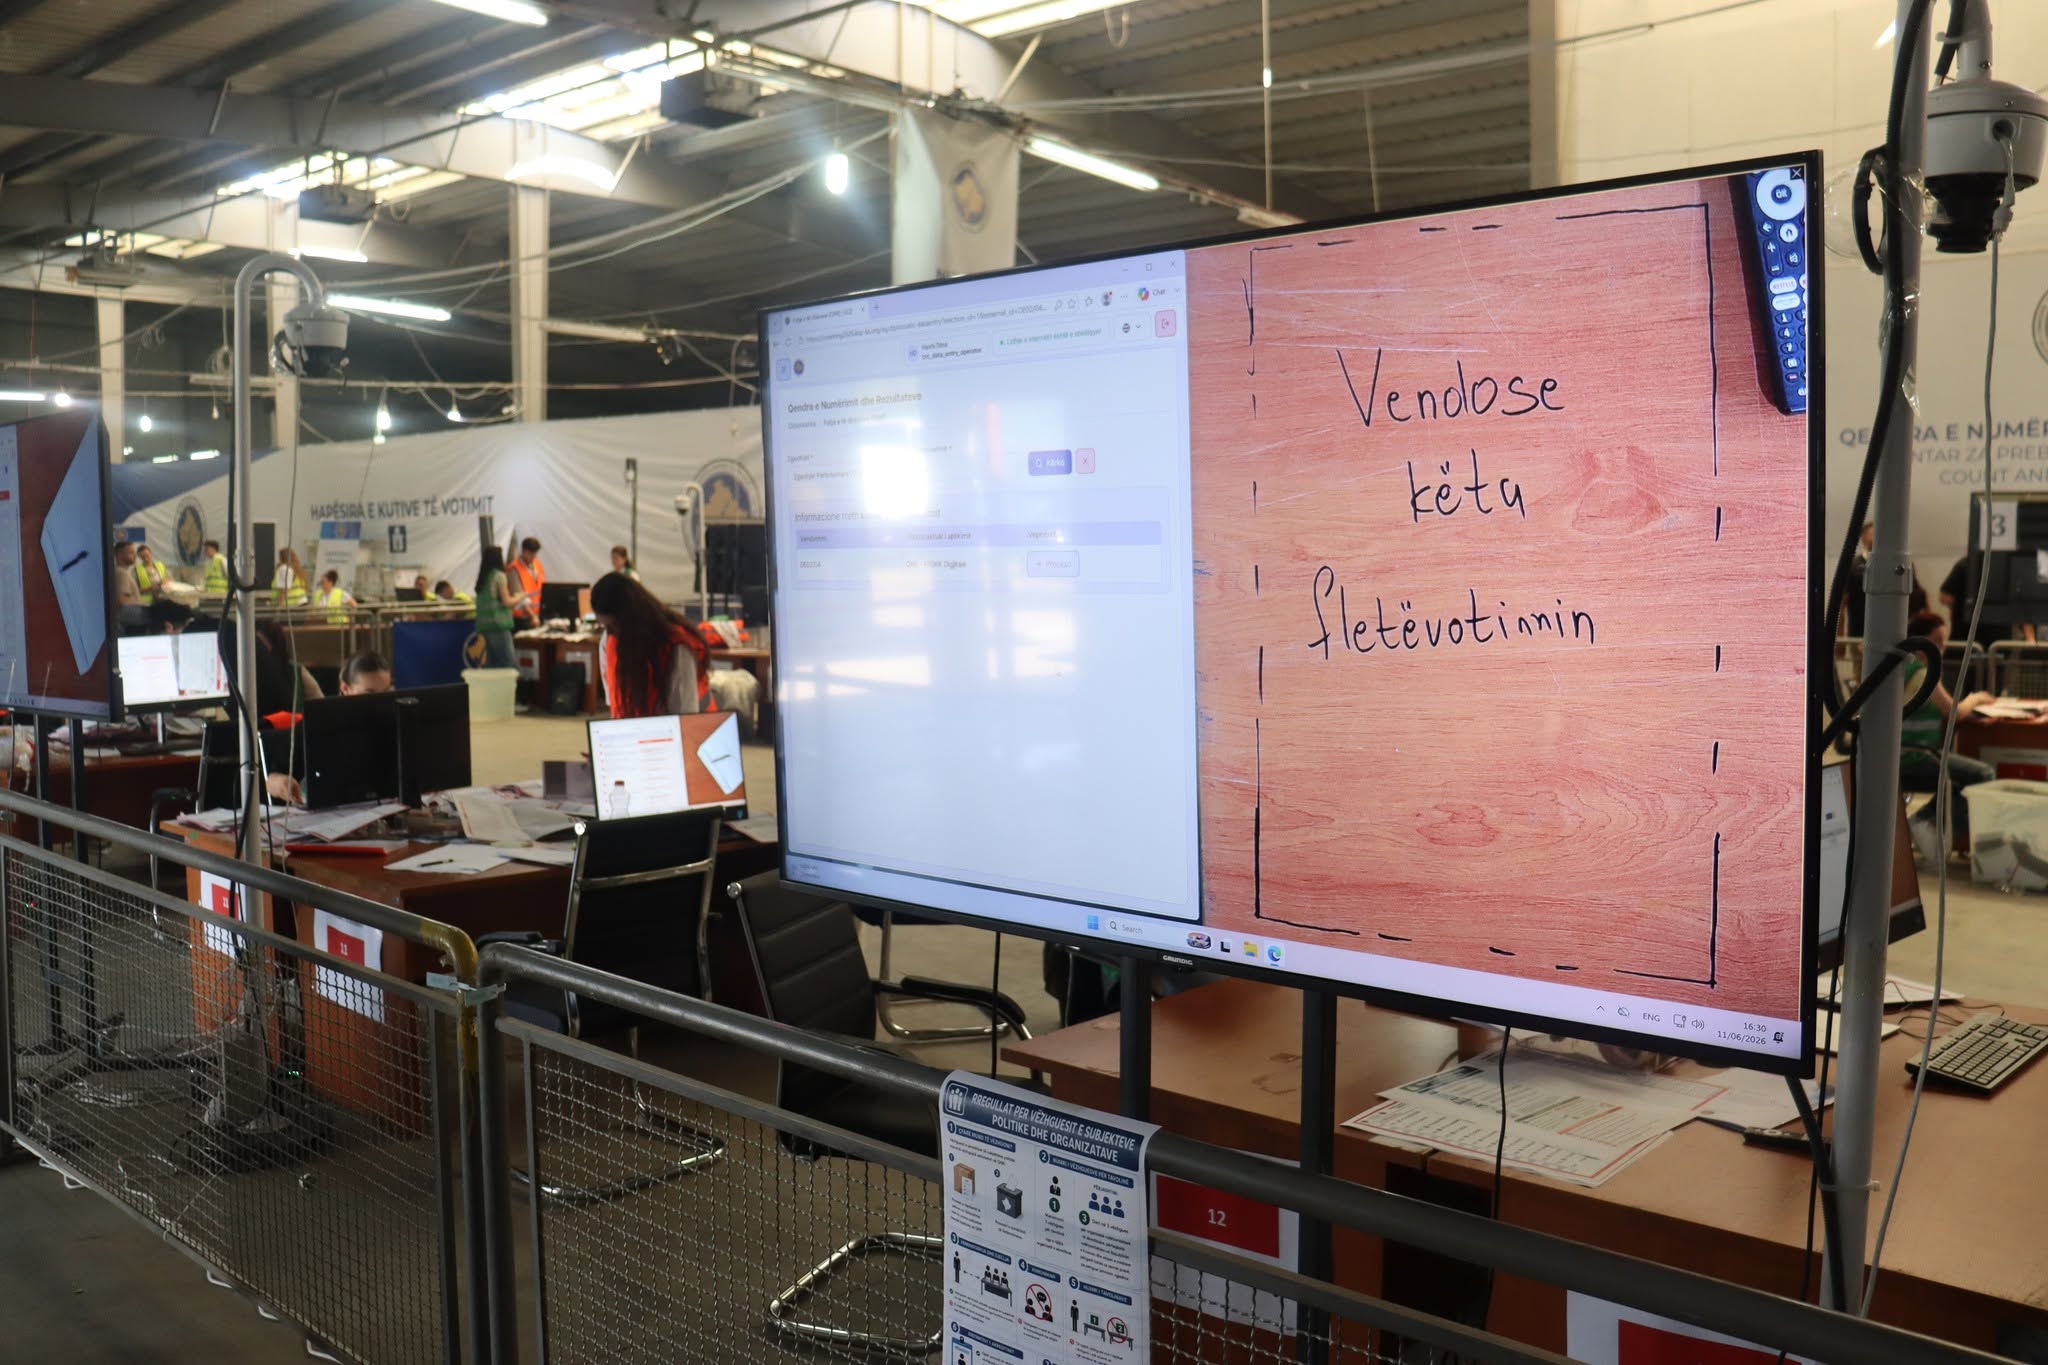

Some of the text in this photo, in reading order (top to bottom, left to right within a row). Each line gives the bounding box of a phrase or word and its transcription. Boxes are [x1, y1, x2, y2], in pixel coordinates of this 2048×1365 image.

[1336, 347, 1566, 427] Vendose
[788, 400, 814, 413] Qendra
[1840, 417, 2048, 447] QERA E NUMË
[2014, 466, 2048, 482] AN
[310, 495, 494, 520] HAPËSIRA E KUTIVE TË VOTIMIT
[1991, 513, 2006, 538] 3
[1121, 924, 1143, 935] Search
[1162, 954, 1193, 966] GRUNDIG
[1642, 1012, 1661, 1023] ENG
[1743, 1021, 1767, 1033] 16:30
[1717, 1030, 1767, 1045] 11/06/2026
[971, 1093, 1015, 1115] RREGULLAT
[1077, 1124, 1085, 1136] E
[1084, 1126, 1136, 1151] SUBJEKTEVE
[992, 1114, 1119, 1162] POLITIKE DHE ORGANIZATAVE
[1207, 1208, 1227, 1227] 12
